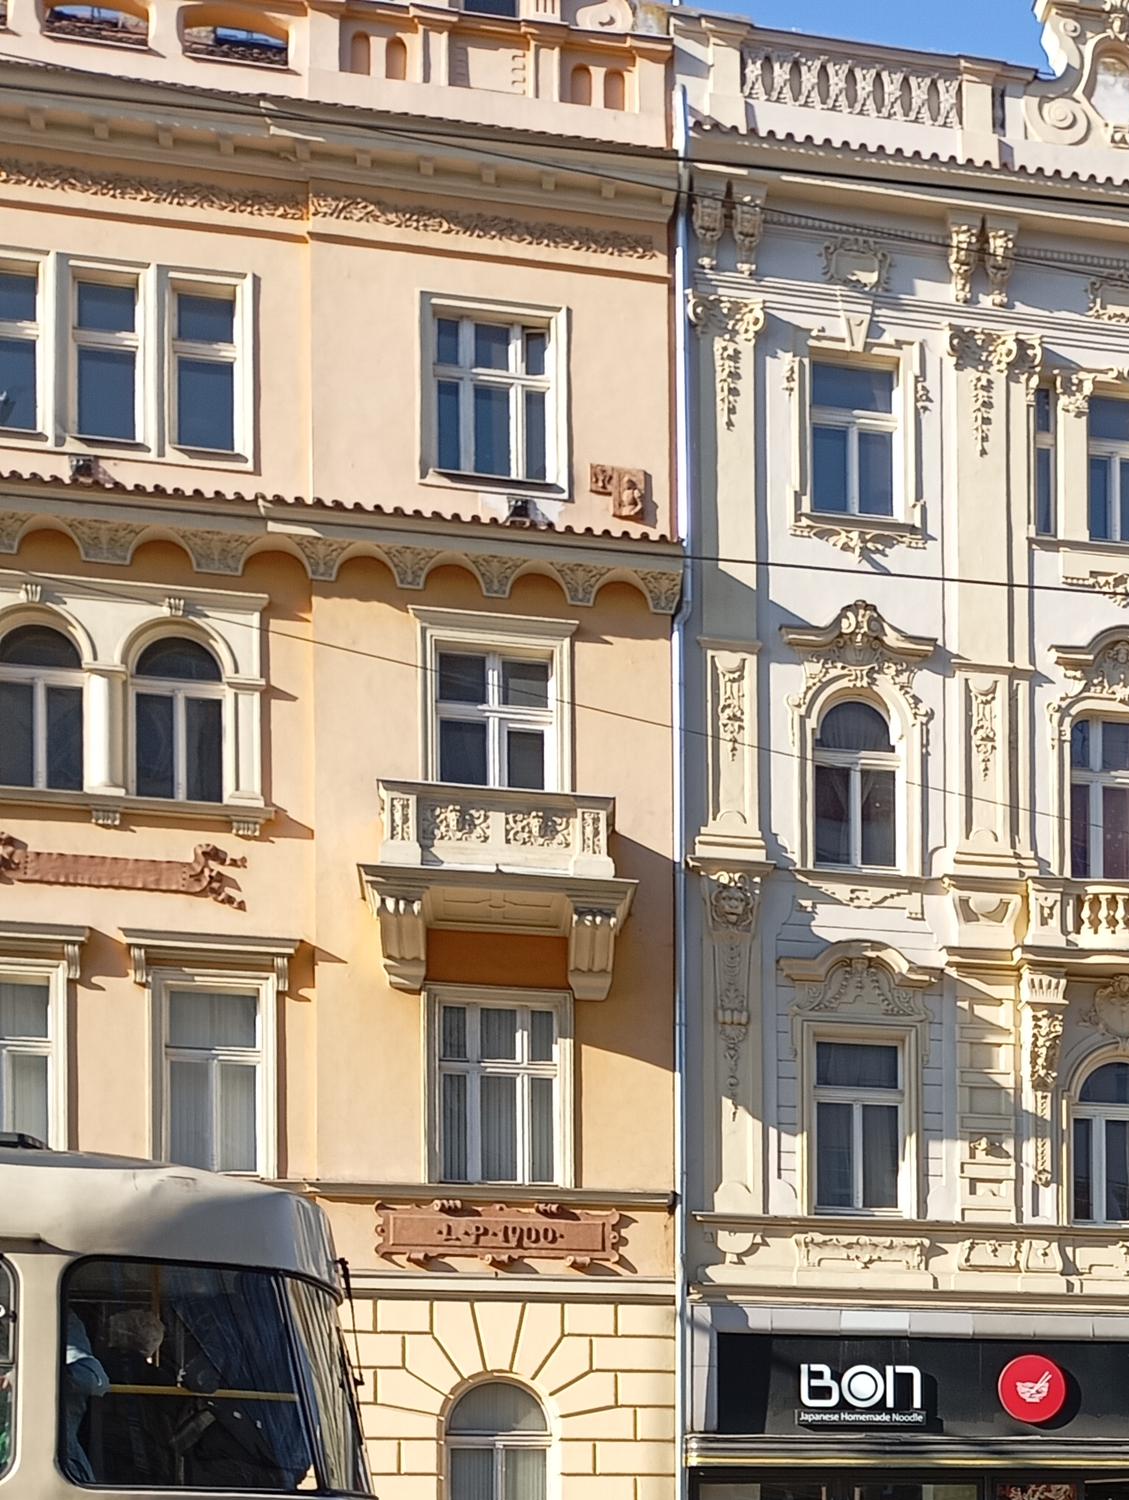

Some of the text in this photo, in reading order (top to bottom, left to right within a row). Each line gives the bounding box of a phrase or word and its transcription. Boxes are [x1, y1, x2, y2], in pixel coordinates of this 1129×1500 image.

[799, 1411, 924, 1423] Japanese Homemade Noodle
